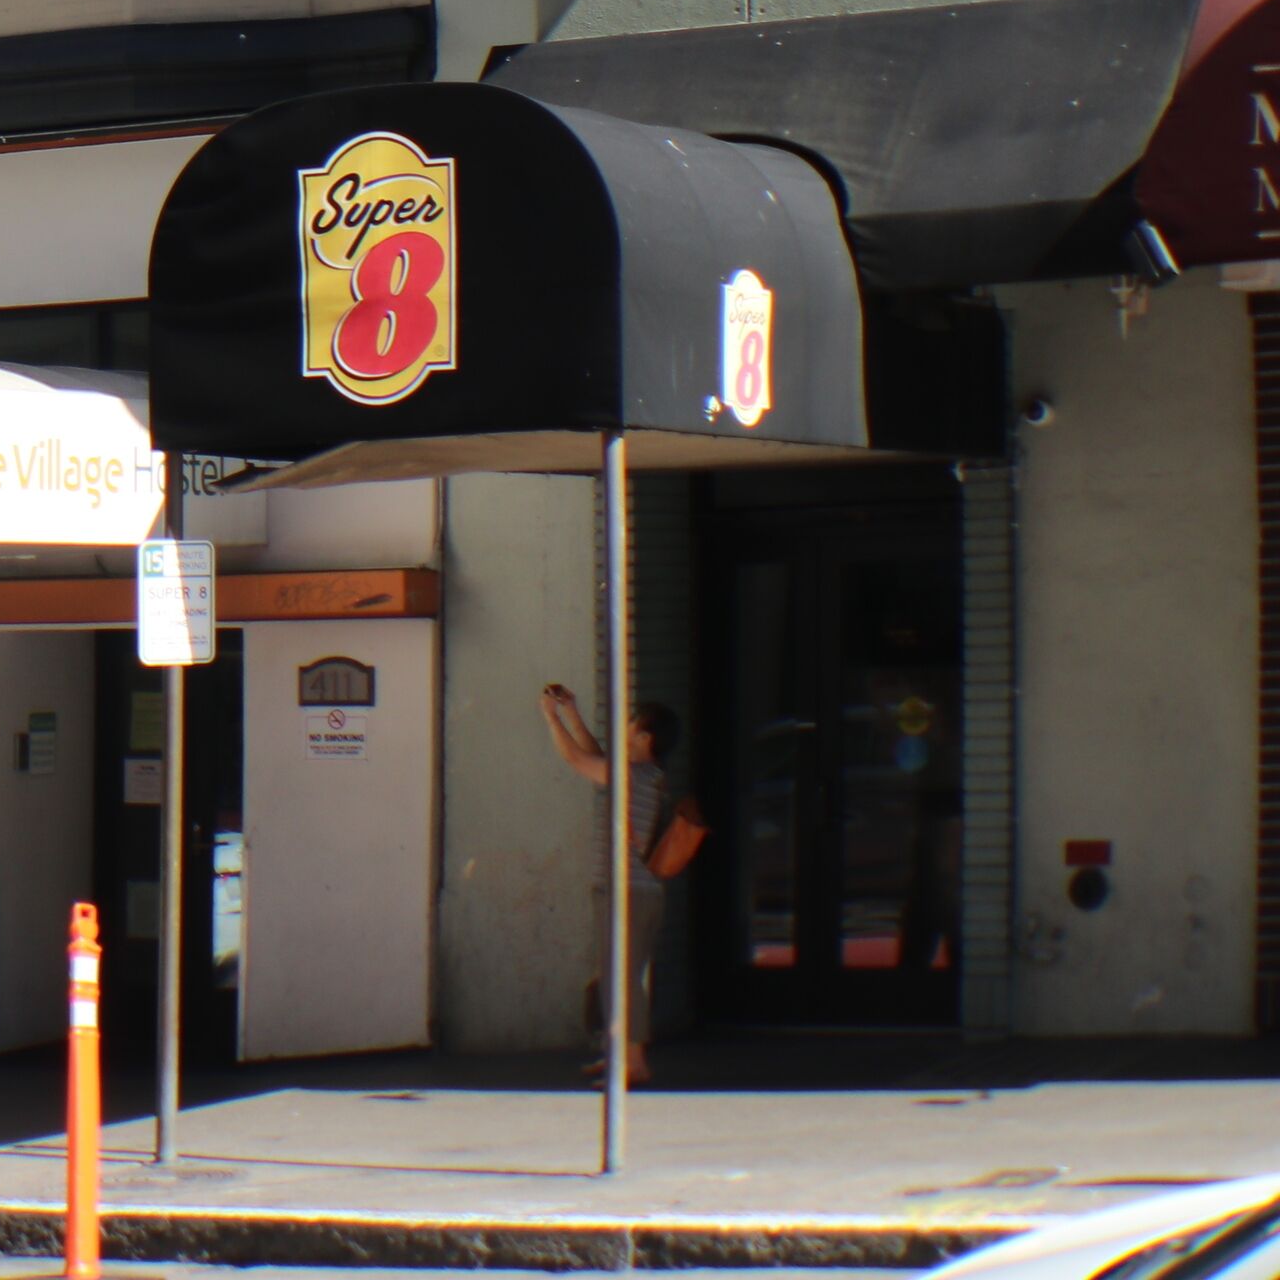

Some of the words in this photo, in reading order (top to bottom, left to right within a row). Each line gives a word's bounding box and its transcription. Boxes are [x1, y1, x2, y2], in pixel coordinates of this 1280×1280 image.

[311, 173, 445, 260] Super
[331, 231, 445, 381] 8
[729, 293, 766, 340] Super
[735, 330, 764, 408] 8
[12, 438, 124, 509] Village
[145, 549, 163, 573] 15
[199, 586, 208, 599] 8
[310, 670, 351, 700] 411
[309, 734, 322, 742] NO
[324, 734, 364, 742] SMOKING
